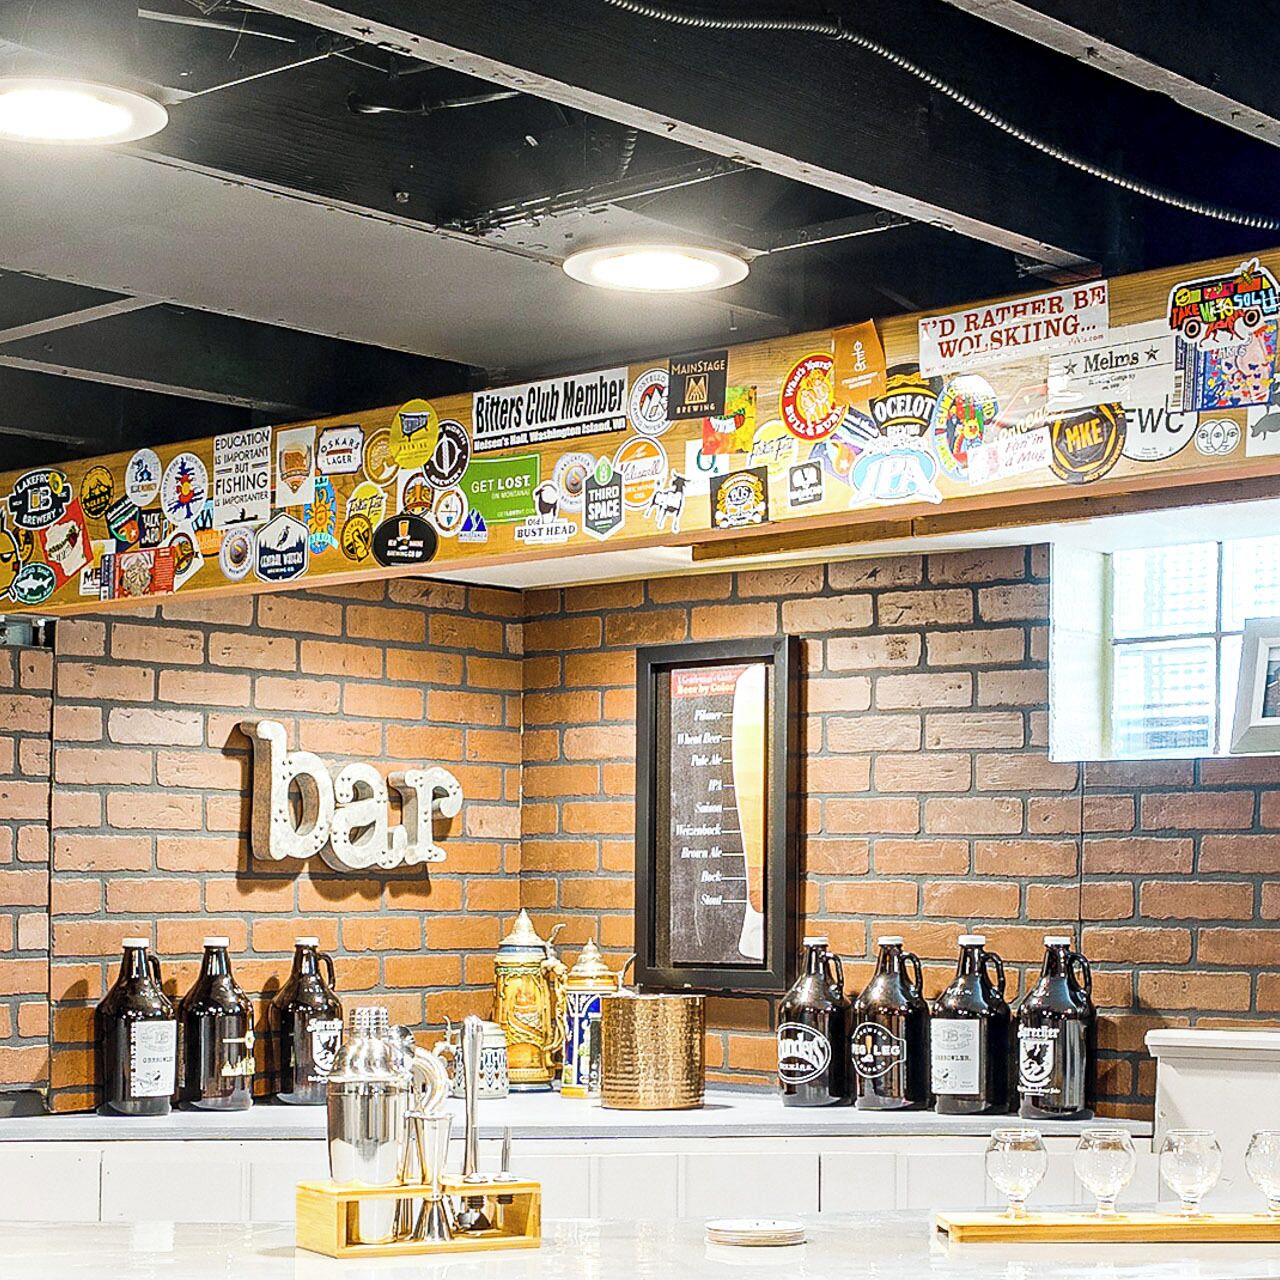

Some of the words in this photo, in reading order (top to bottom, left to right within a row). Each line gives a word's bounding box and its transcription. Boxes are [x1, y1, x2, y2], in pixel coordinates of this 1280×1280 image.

[964, 295, 1064, 332] RATHER
[1073, 285, 1106, 310] BE
[1171, 303, 1200, 330] TAKE
[1199, 301, 1216, 322] ME
[938, 314, 1096, 358] WOLSKIING...
[671, 360, 725, 375] MAINSTAGE
[1083, 351, 1139, 373] Melms
[784, 364, 807, 398] What's
[476, 394, 523, 433] Bitters
[526, 384, 560, 426] Club
[561, 375, 625, 419] Member
[676, 403, 715, 414] BREWING
[874, 394, 936, 421] OCELOT
[785, 405, 805, 435] BULL
[446, 425, 467, 446] NORTH
[529, 423, 581, 443] Washington
[582, 419, 612, 435] Island,
[613, 418, 626, 430] WI
[1065, 418, 1104, 452] MKE
[215, 431, 270, 451] EDUCATION
[321, 437, 360, 453] OSKARS
[215, 454, 221, 465] IS
[224, 446, 269, 463] IMPORTANT
[326, 455, 352, 465] LAGER
[235, 462, 249, 473] BUT
[216, 472, 268, 495] FISHING
[472, 480, 494, 493] GET
[498, 475, 530, 490] LOST.
[215, 498, 219, 507] IS
[222, 491, 269, 505] IMPORTANTER
[588, 485, 620, 502] THIRD
[22, 508, 56, 525] BREWERY
[588, 501, 620, 520] SPACE
[528, 518, 540, 526] Old
[517, 526, 543, 538] BUST
[546, 525, 576, 535] HEAD
[699, 684, 709, 696] by
[703, 732, 722, 744] Beer
[691, 754, 708, 766] Pale
[709, 754, 722, 766] Ale
[248, 721, 463, 872] bar
[676, 823, 721, 836] Weizenbock
[681, 847, 708, 858] Brown
[709, 846, 722, 858] Ale
[701, 870, 721, 882] Bock
[701, 894, 722, 905] Stout
[874, 1045, 900, 1056] LEG
